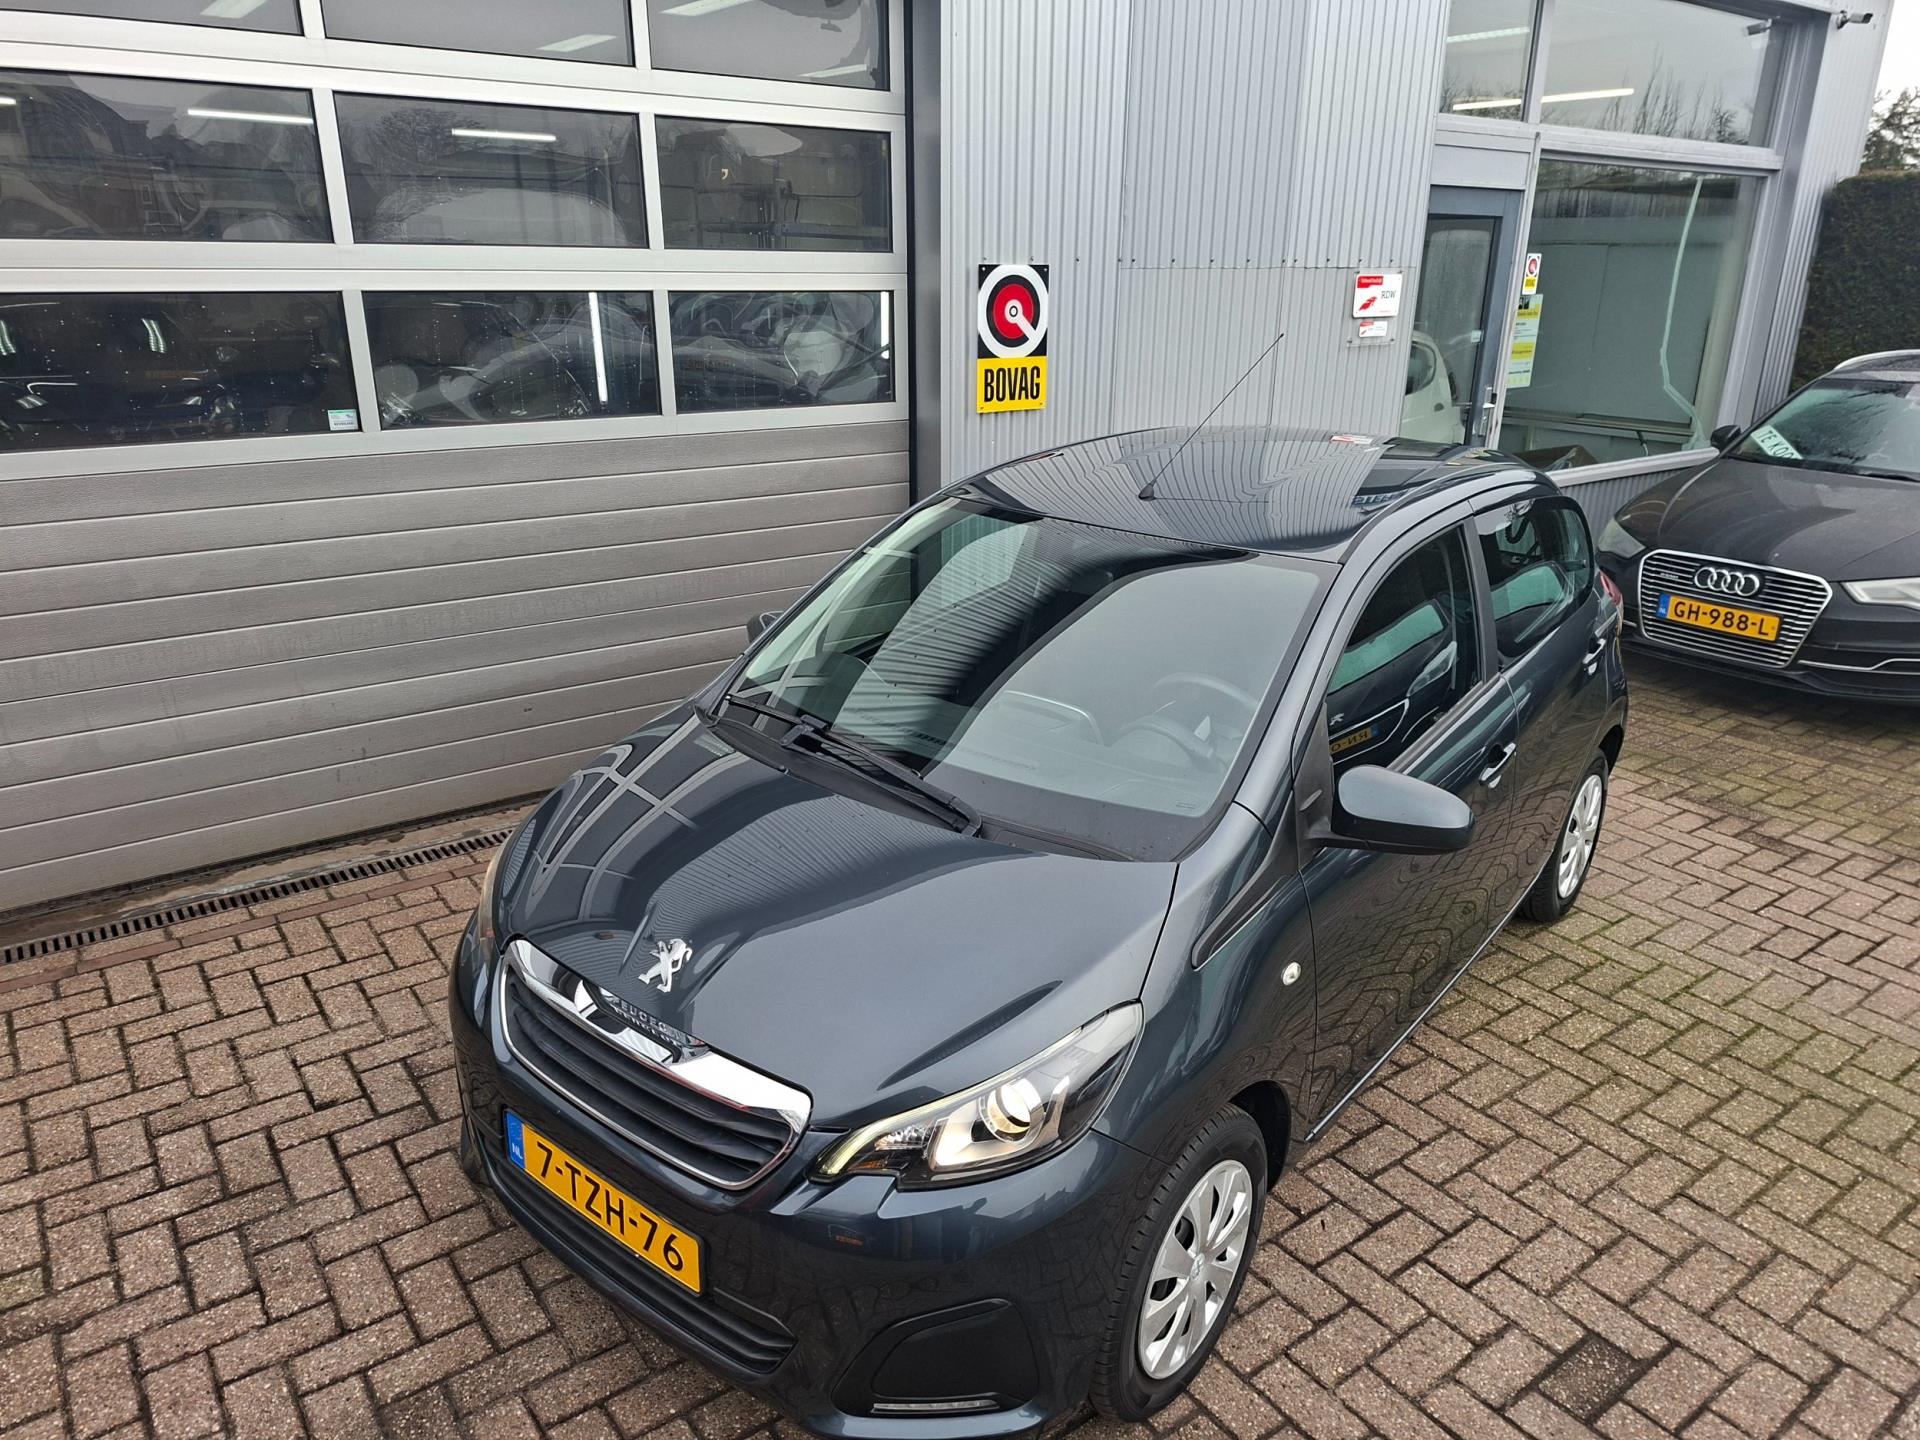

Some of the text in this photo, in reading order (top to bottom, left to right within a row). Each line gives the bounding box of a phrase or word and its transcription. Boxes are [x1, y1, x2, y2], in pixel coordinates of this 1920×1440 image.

[1381, 290, 1397, 299] RDW
[984, 366, 1041, 402] BOVAG
[1758, 430, 1777, 443] TE
[1674, 601, 1769, 636] GH-988-L
[511, 1141, 684, 1272] NL 7-TZH-76
